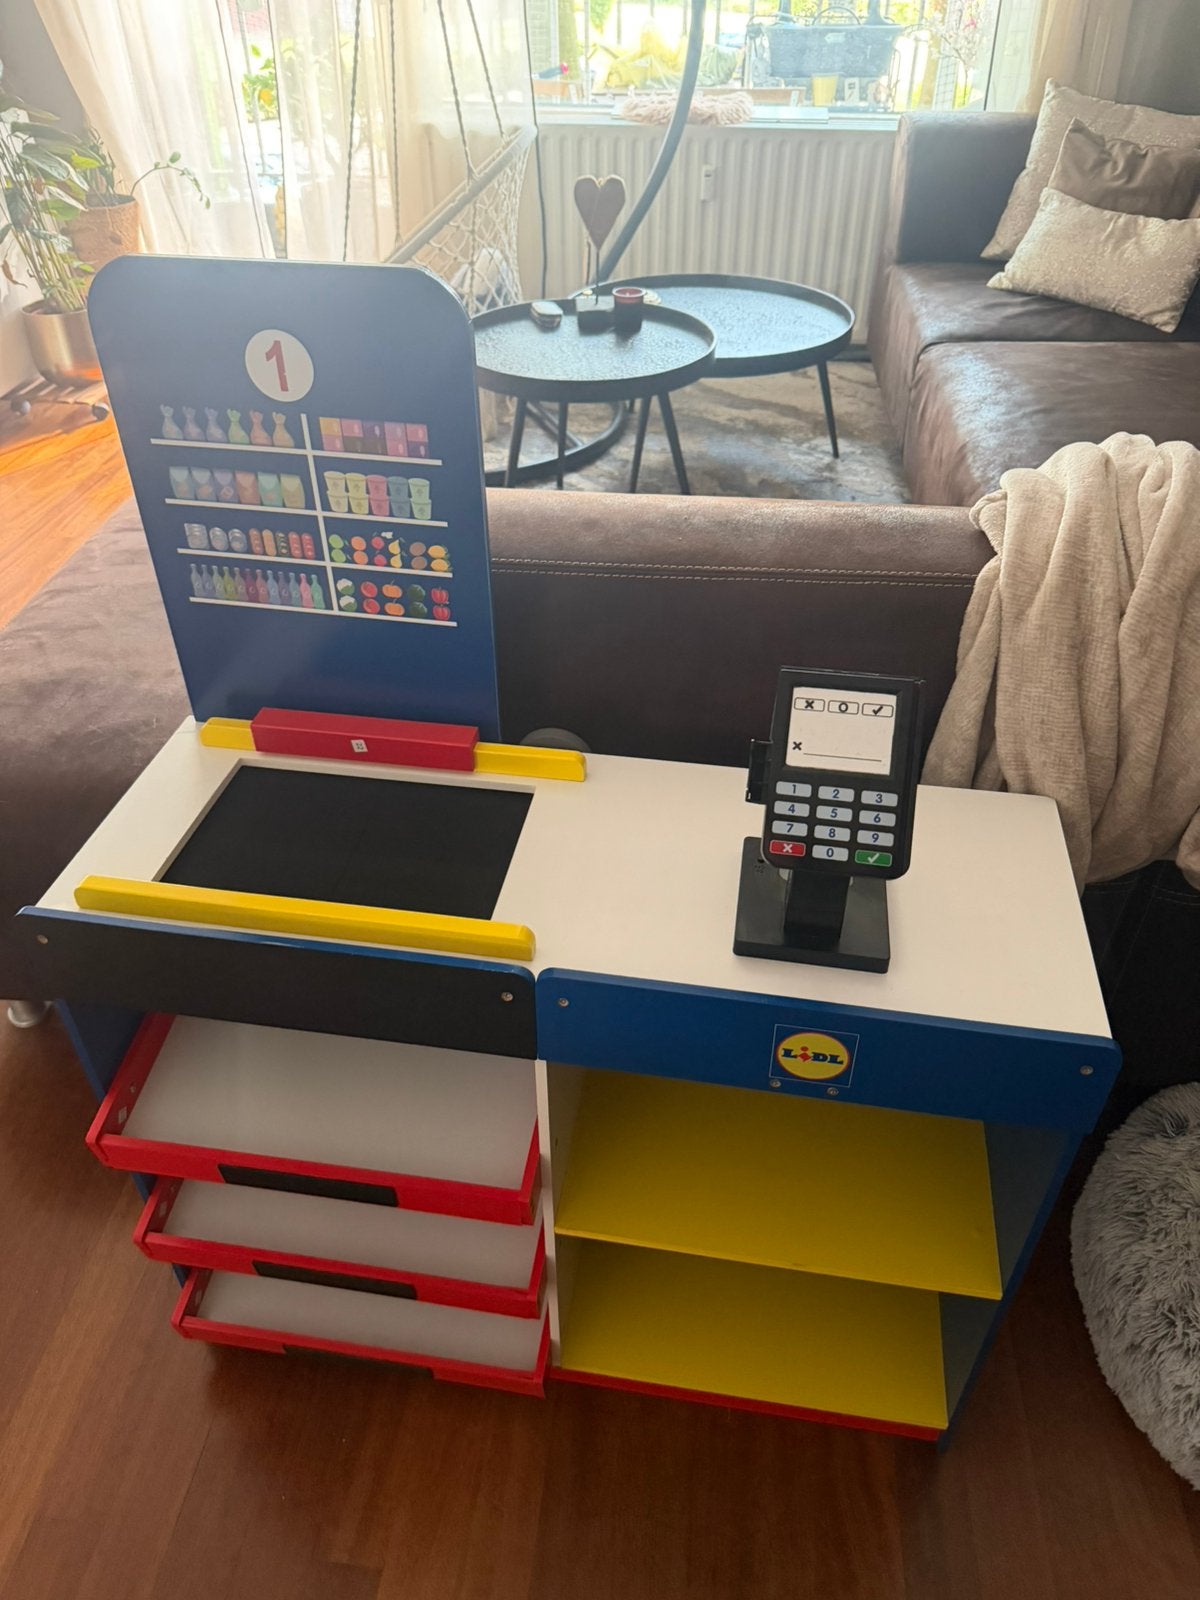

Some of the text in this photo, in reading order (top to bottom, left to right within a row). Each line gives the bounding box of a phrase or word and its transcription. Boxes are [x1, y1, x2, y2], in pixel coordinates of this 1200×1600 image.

[265, 340, 289, 392] 1
[791, 783, 884, 804] 1 2 3
[787, 803, 882, 824] 4 5 6
[786, 822, 880, 843] 7 8 9
